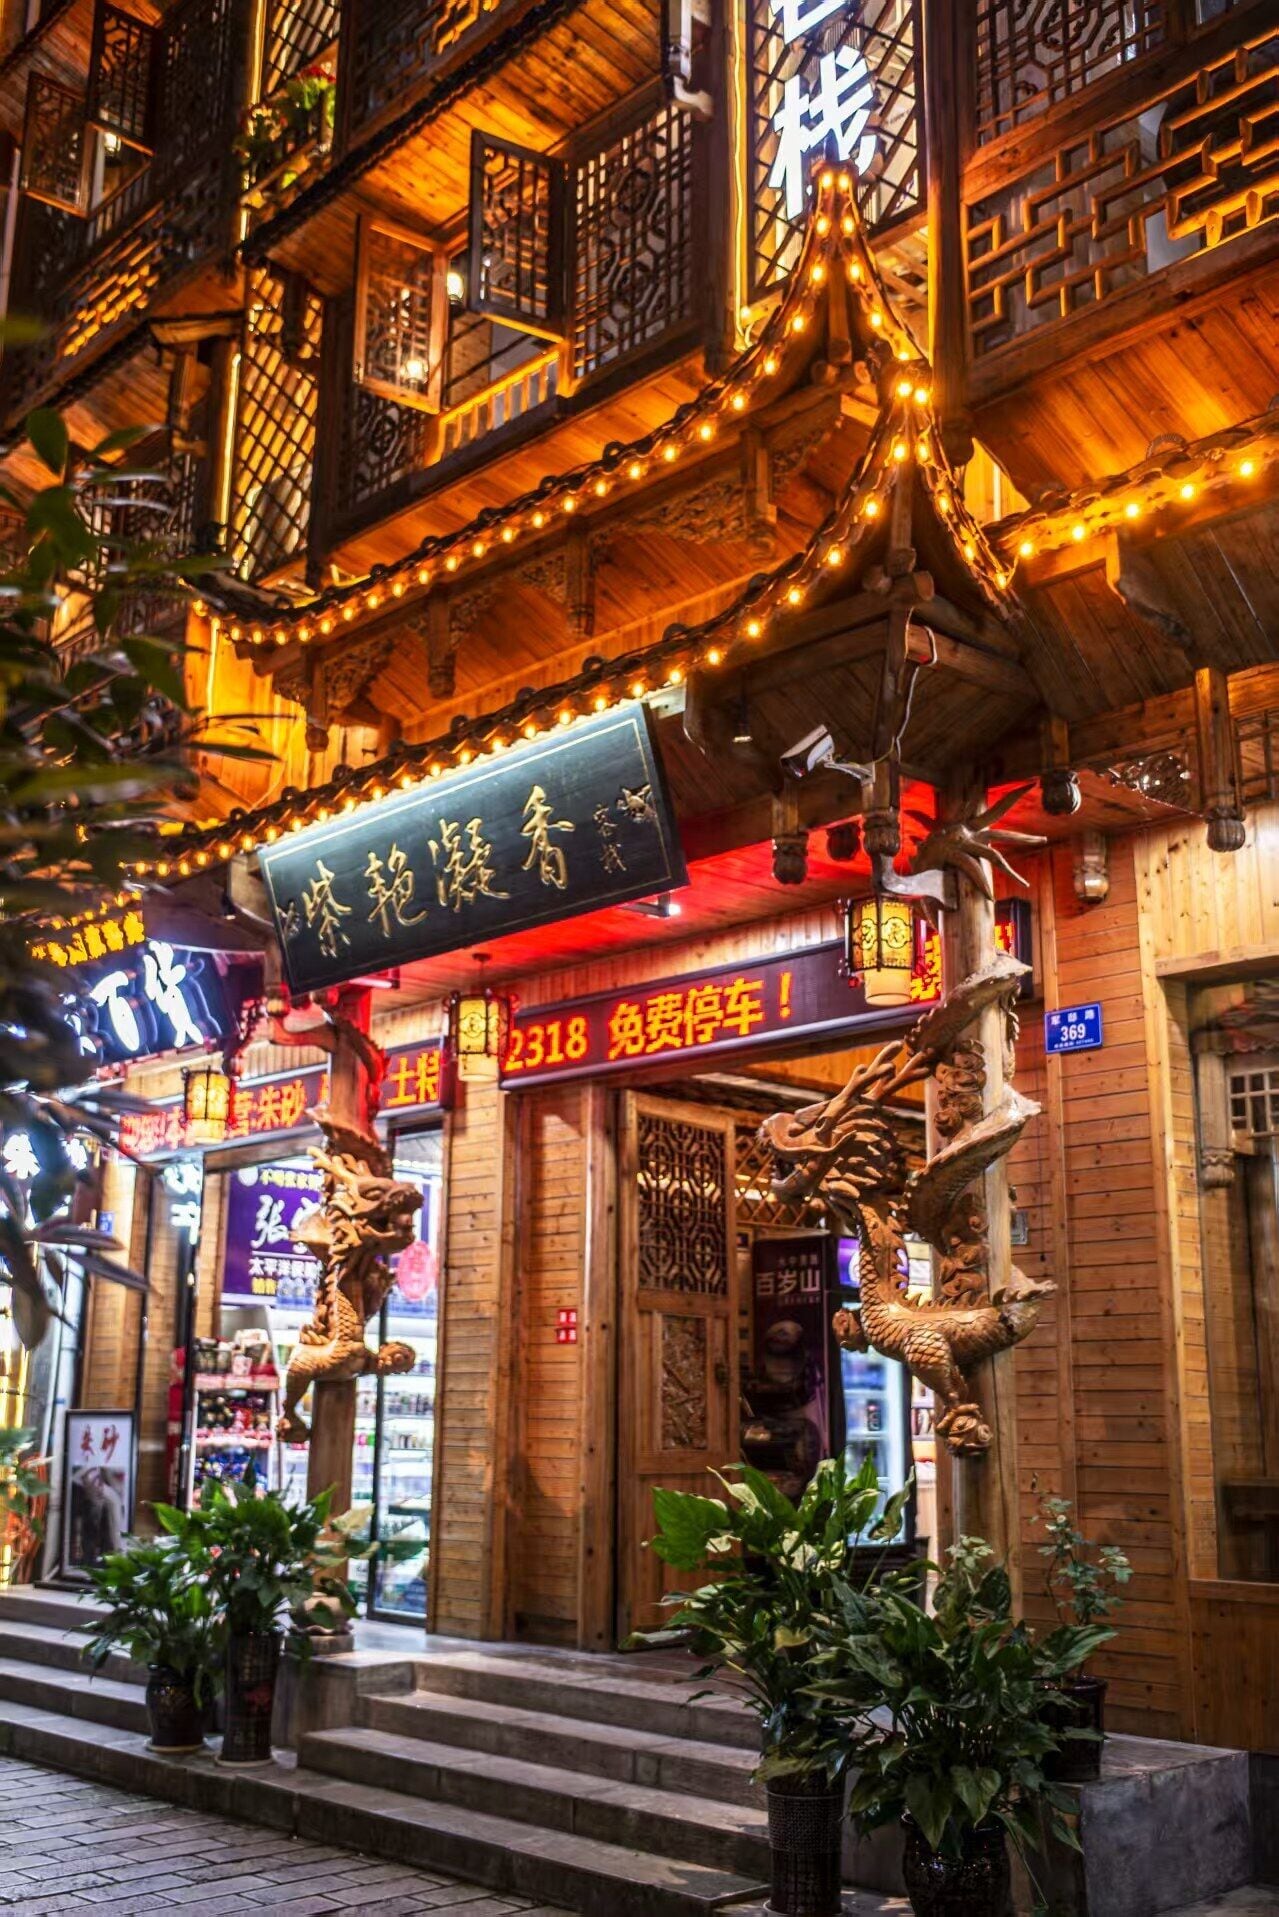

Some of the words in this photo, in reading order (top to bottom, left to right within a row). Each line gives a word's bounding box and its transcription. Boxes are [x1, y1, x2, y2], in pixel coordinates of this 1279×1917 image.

[768, 0, 877, 221] 栈
[1061, 1023, 1086, 1042] 369
[756, 1267, 821, 1297] 百岁山
